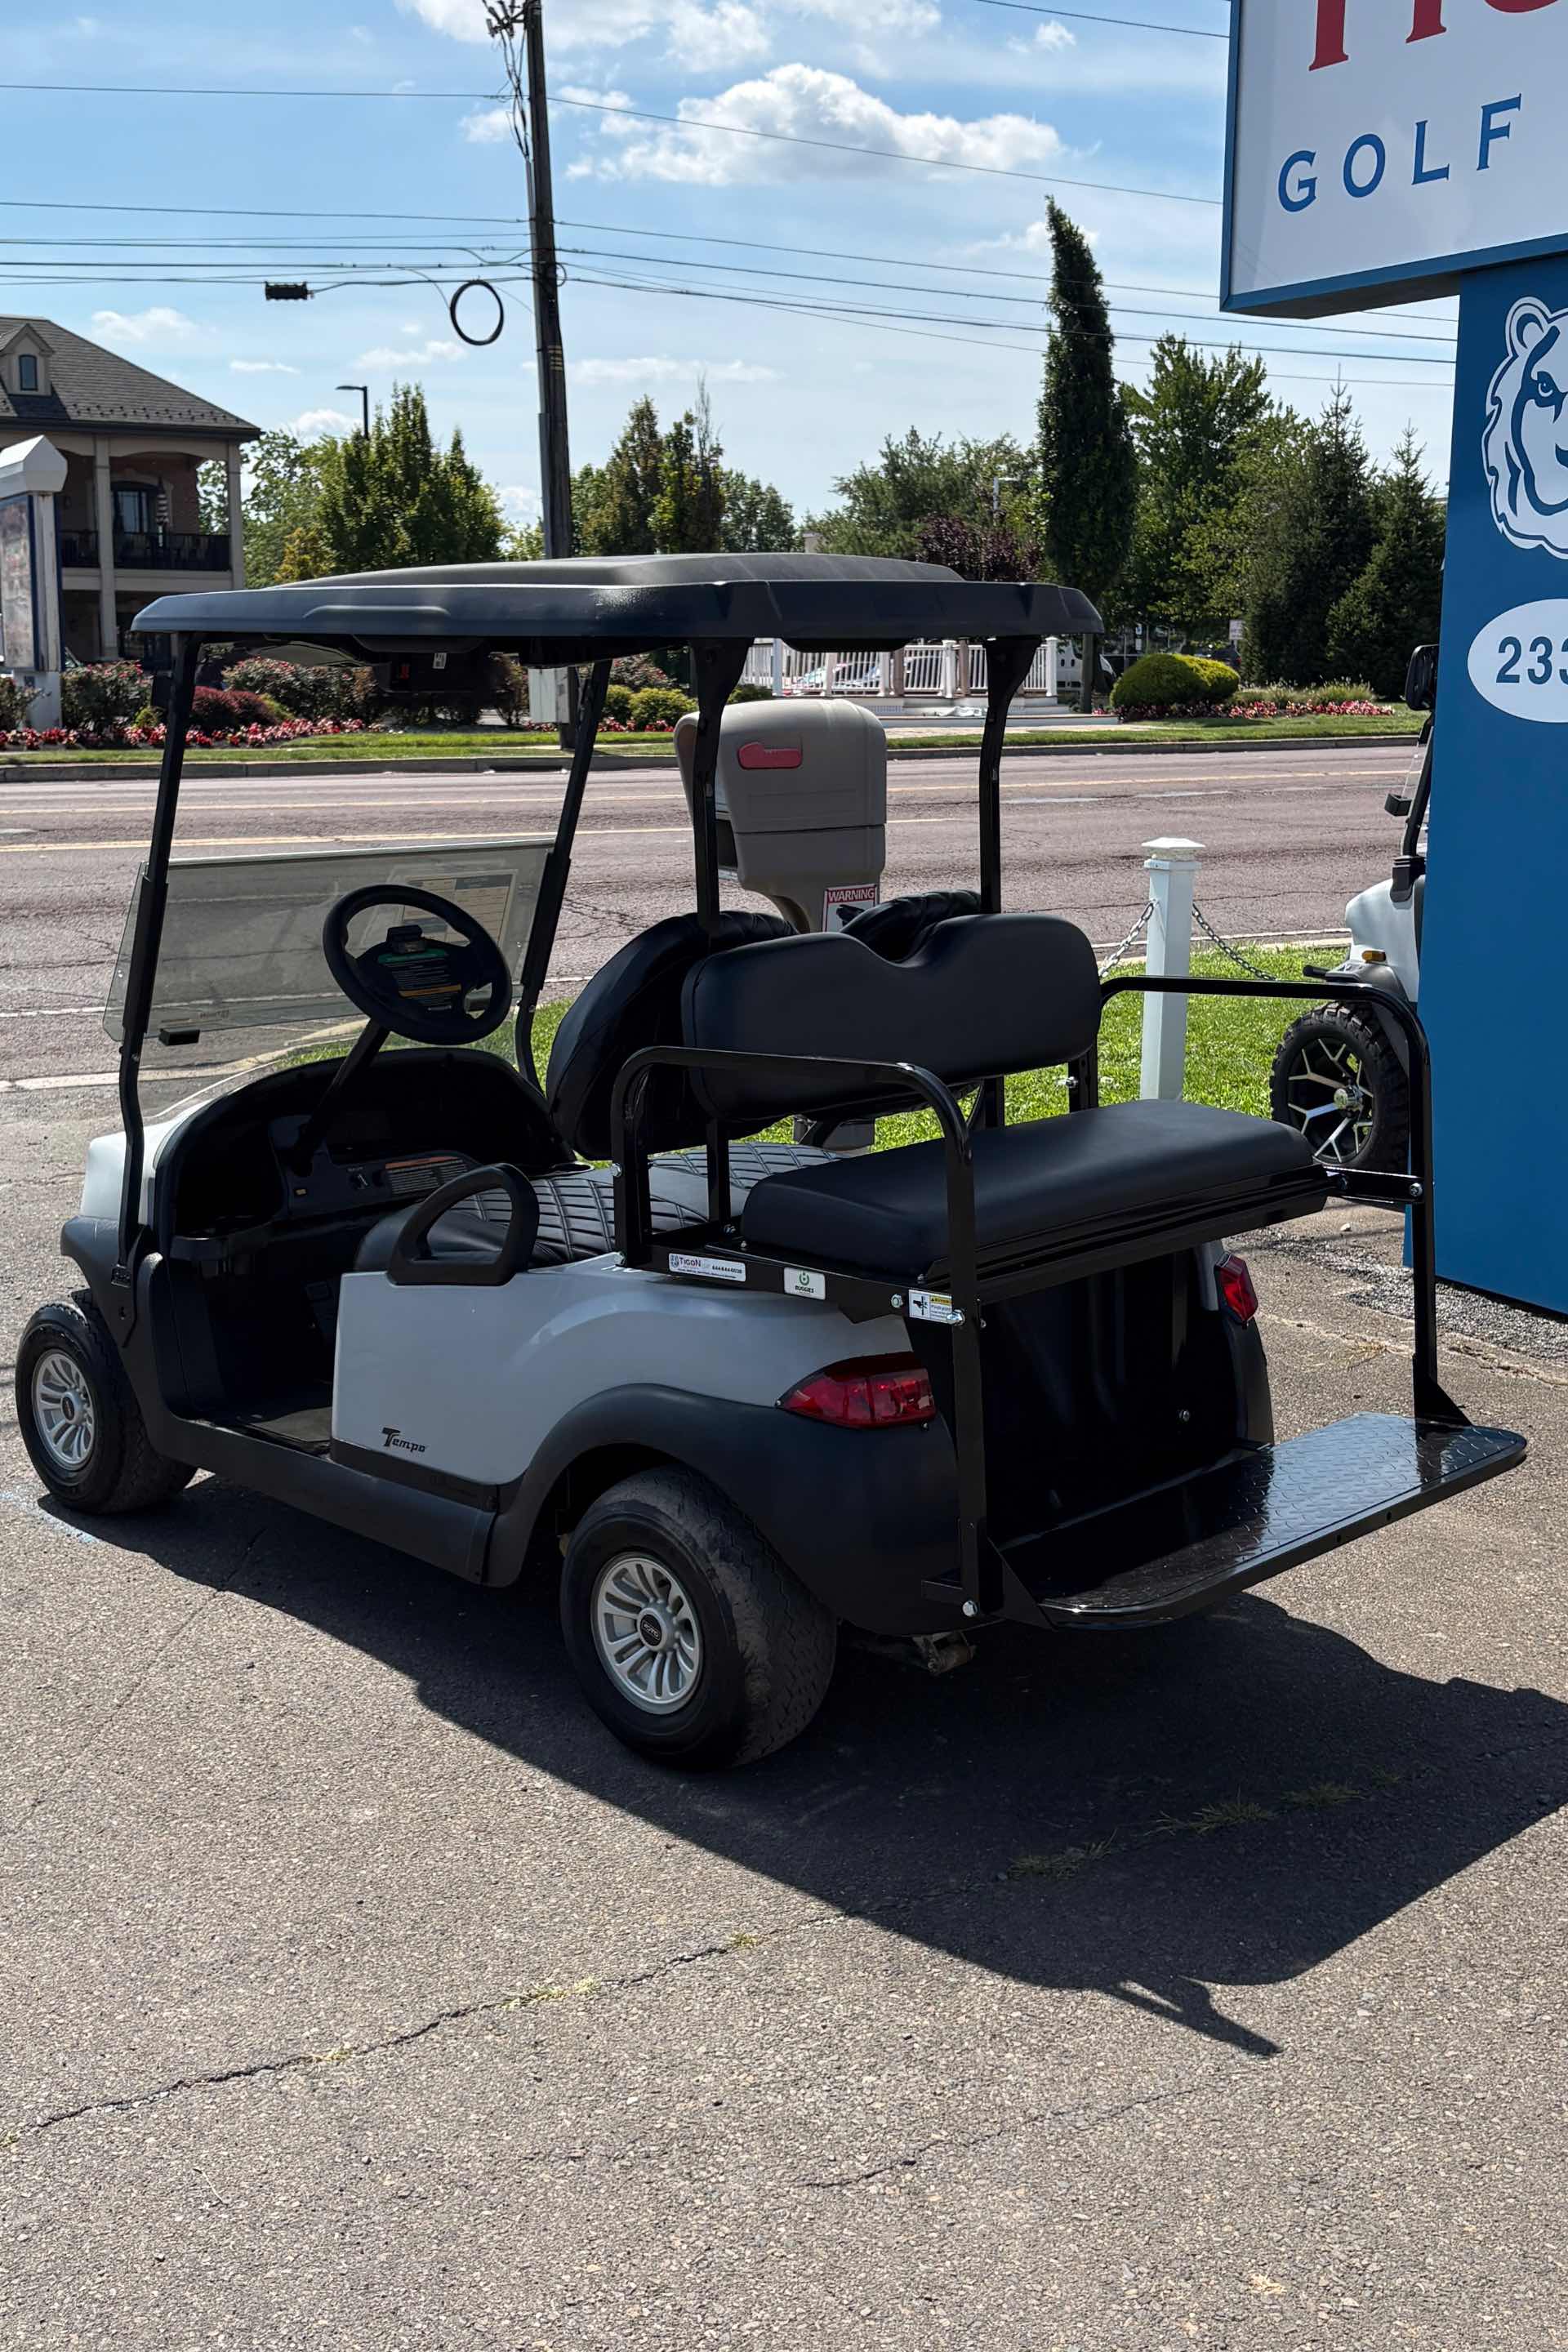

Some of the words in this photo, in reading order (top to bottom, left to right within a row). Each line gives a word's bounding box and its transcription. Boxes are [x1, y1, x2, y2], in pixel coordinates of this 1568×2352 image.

[1278, 93, 1521, 212] GOLF
[828, 888, 875, 902] WARNING
[381, 1427, 425, 1453] Tempo
